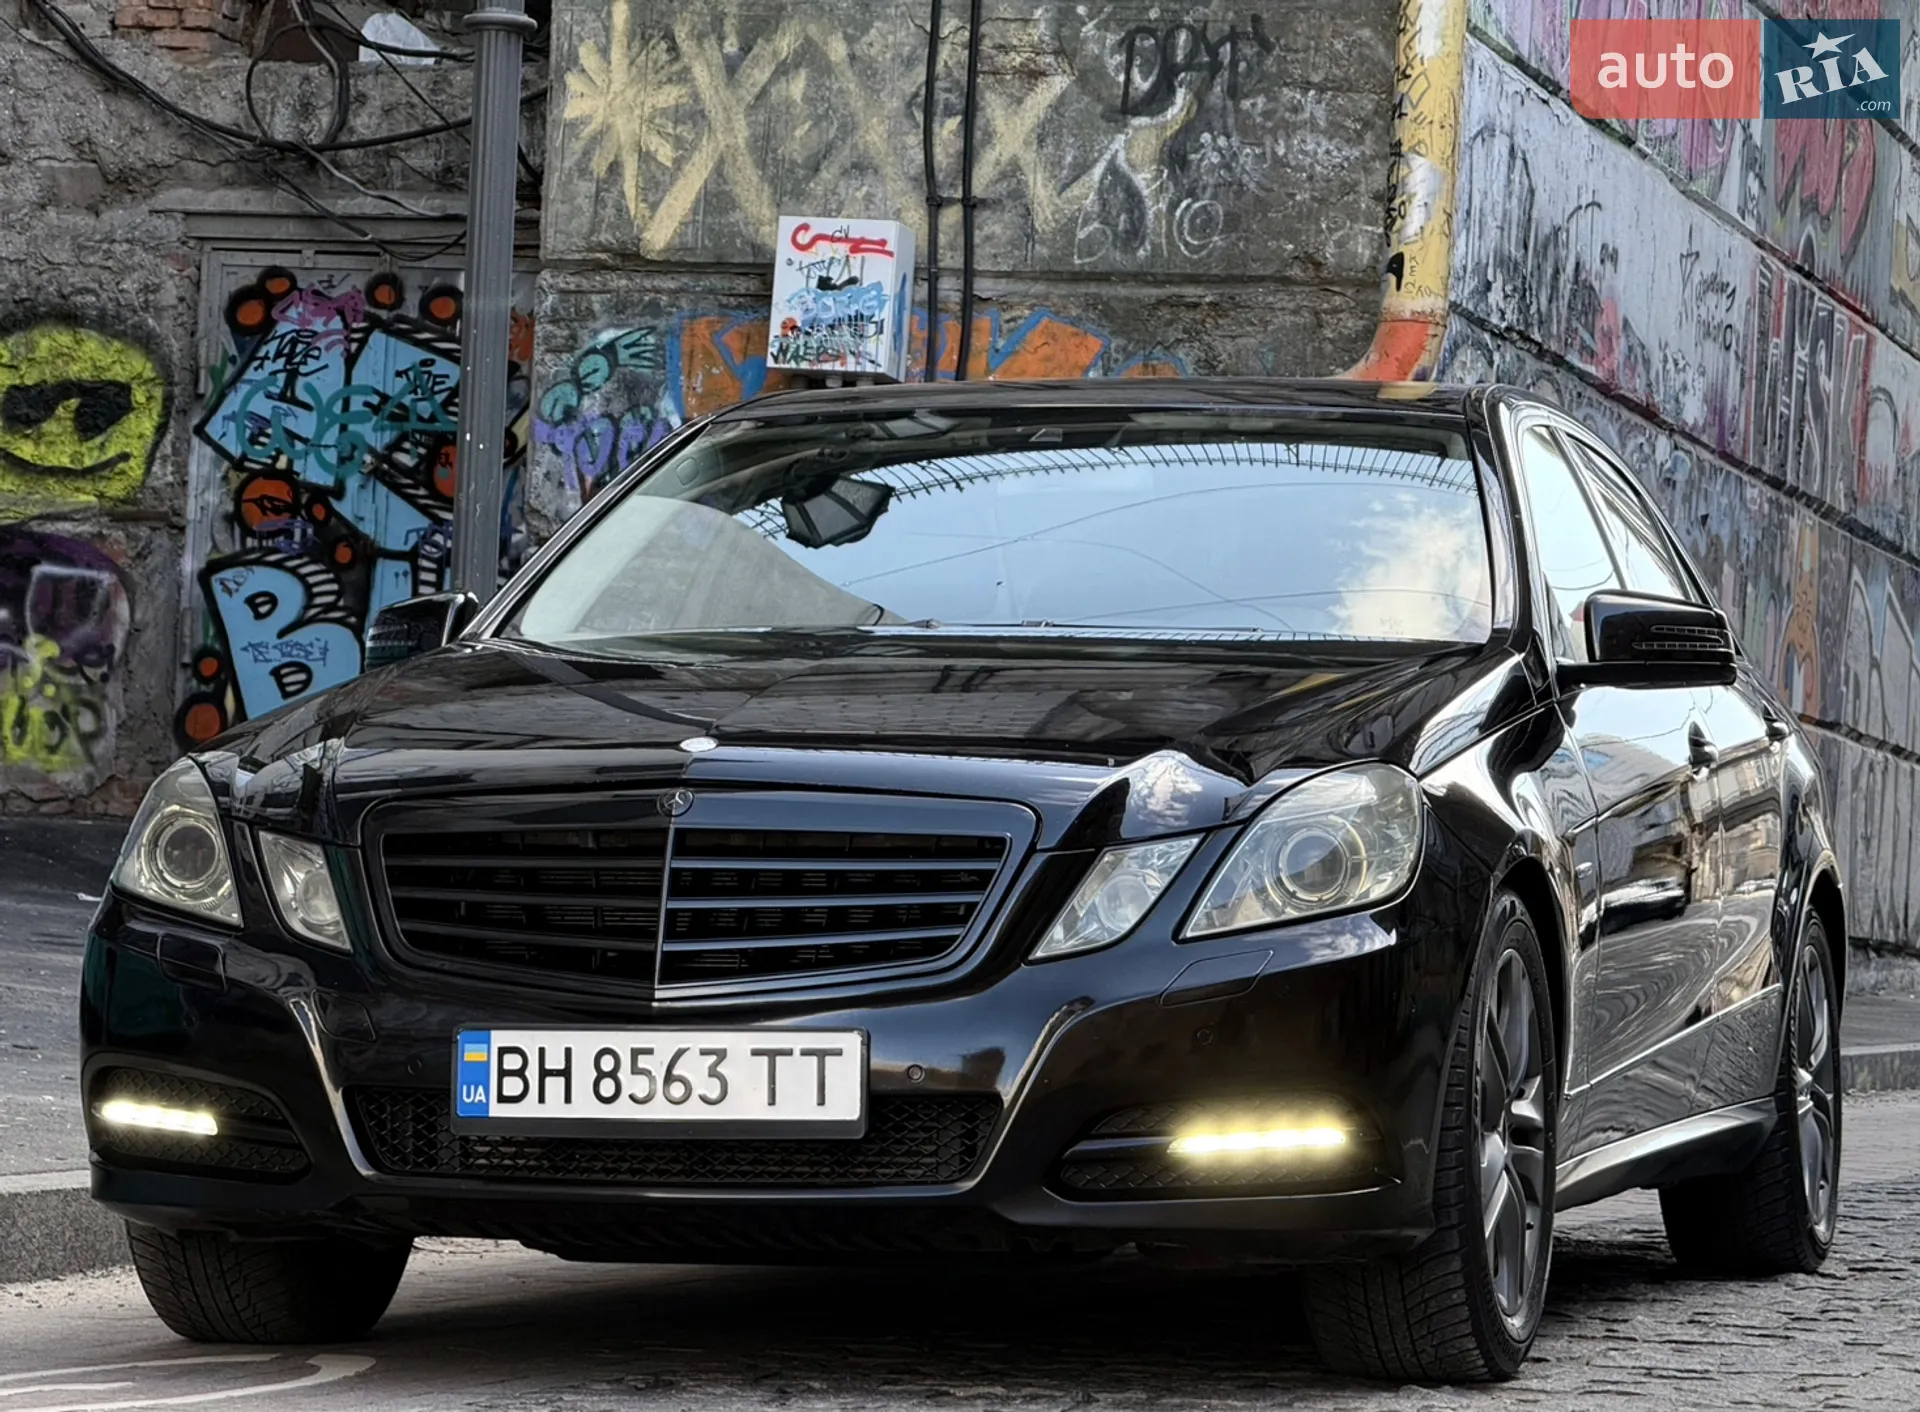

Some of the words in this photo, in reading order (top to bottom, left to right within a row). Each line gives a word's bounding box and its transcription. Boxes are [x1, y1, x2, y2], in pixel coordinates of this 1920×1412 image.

[462, 1084, 487, 1104] UA
[496, 1045, 573, 1104] BH
[592, 1046, 729, 1106] 8563
[750, 1047, 843, 1107] TT
